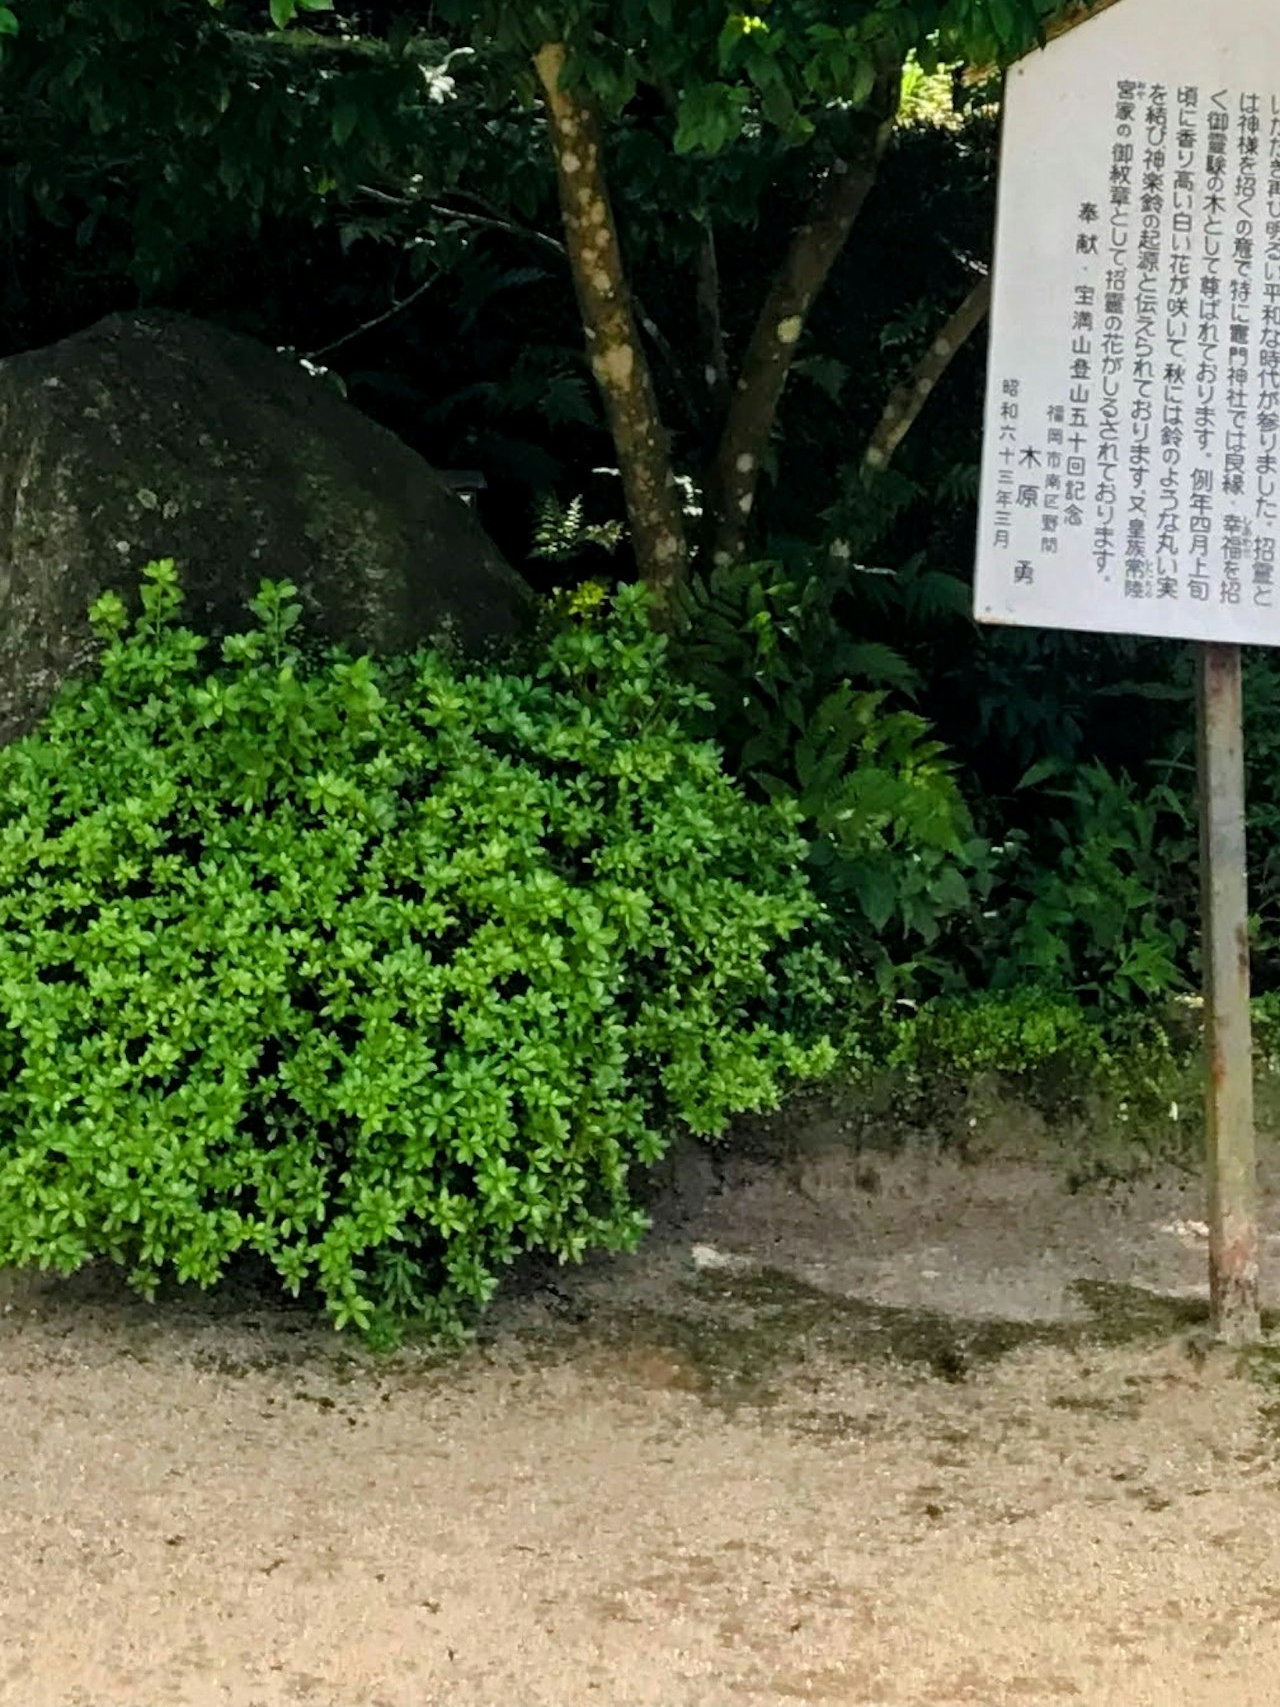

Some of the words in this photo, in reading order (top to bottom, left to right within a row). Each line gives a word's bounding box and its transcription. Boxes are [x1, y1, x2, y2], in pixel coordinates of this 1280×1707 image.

[993, 379, 1019, 550] 昭和六十三年三月
